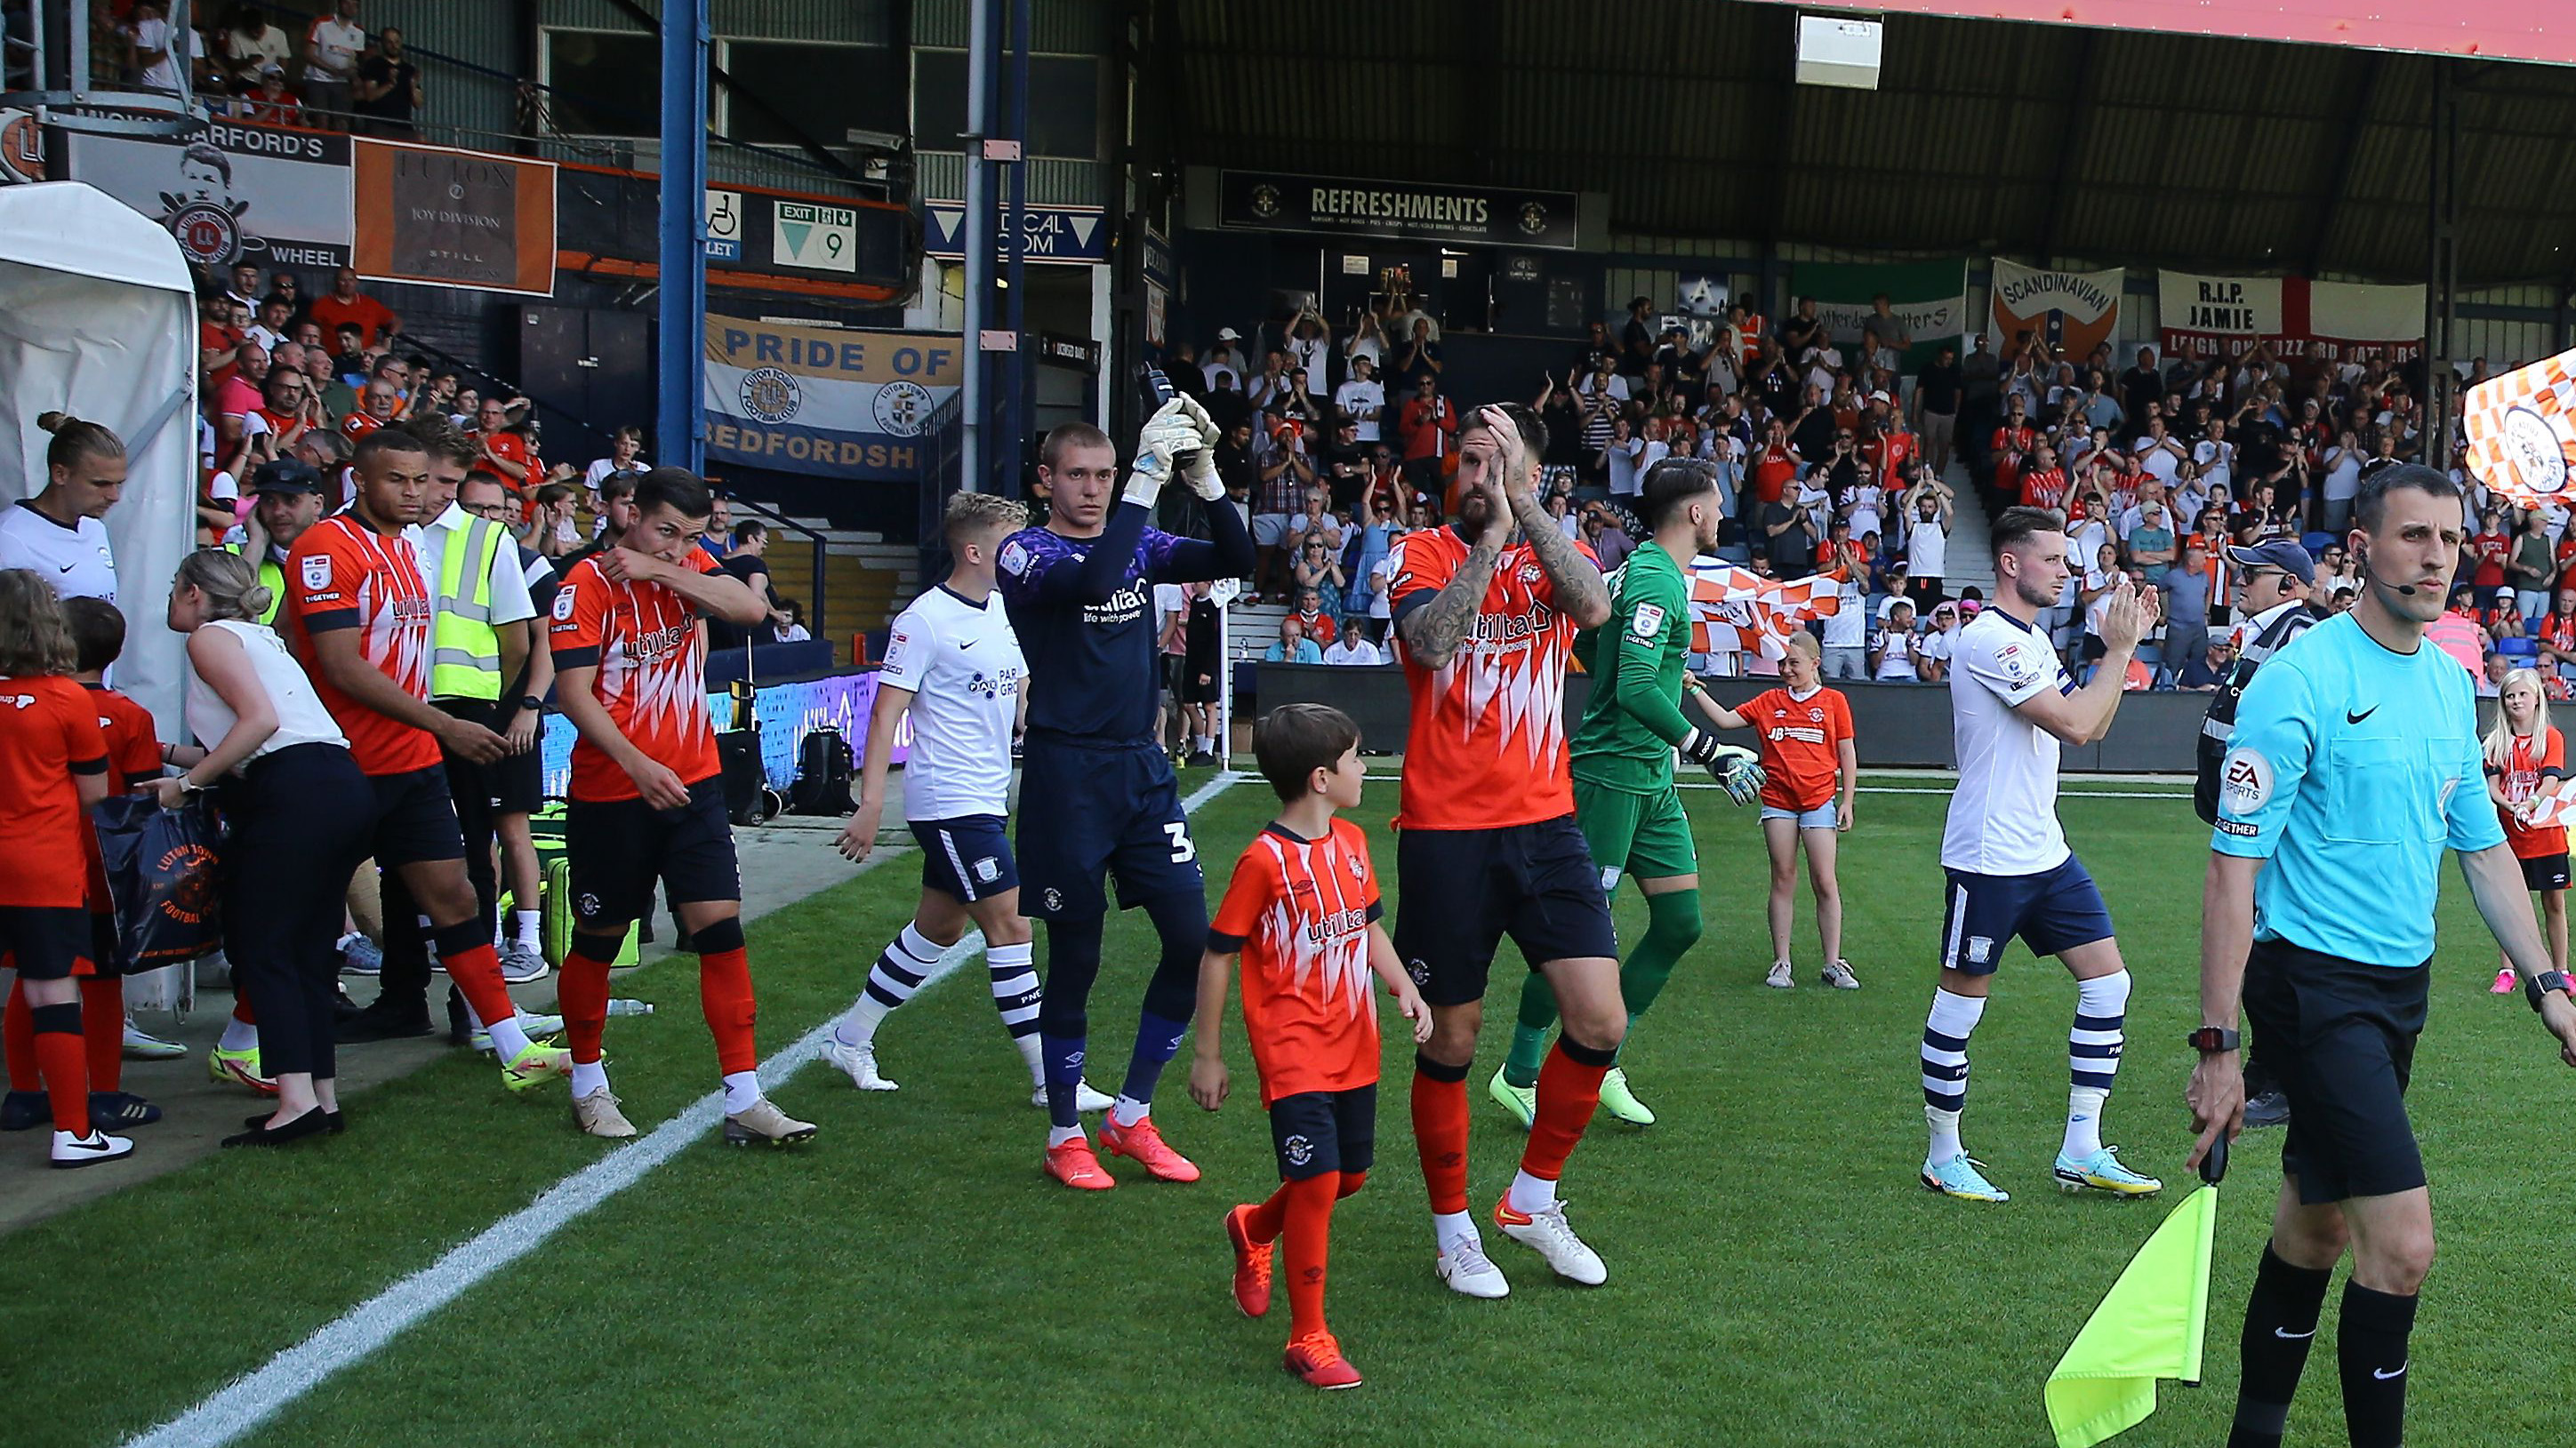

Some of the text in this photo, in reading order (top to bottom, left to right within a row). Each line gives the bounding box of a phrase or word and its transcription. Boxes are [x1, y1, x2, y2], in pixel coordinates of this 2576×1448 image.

[172, 124, 324, 158] ARFORD'S
[783, 205, 811, 220] EXIT
[1312, 188, 1488, 223] REFRESHMENTS
[439, 210, 501, 228] DIVISION
[1459, 225, 1487, 234] CHOCOLATE
[270, 245, 341, 268] WHEEL
[429, 250, 484, 263] STILL
[706, 241, 734, 257] LET
[826, 233, 842, 260] 9
[2003, 273, 2110, 312] SCANDINAVIAN
[2198, 280, 2244, 304] R.I.P.
[2189, 306, 2254, 330] JAMIE
[725, 327, 951, 376] PRIDE OF
[743, 370, 771, 388] LUTON
[880, 383, 904, 399] LUTON
[1083, 612, 1098, 623] life
[1100, 612, 1119, 623] with
[1768, 727, 1785, 741] JB
[2227, 760, 2261, 790] EA
[2226, 780, 2260, 801] SPORTS
[1163, 821, 1196, 863] 3
[157, 844, 189, 871] LUTON
[160, 900, 201, 924] FOOTBAL
[1307, 908, 1365, 941] utilita
[1021, 988, 1042, 1004] PNE
[2107, 1044, 2123, 1055] PN
[1955, 1065, 1969, 1076] PN
